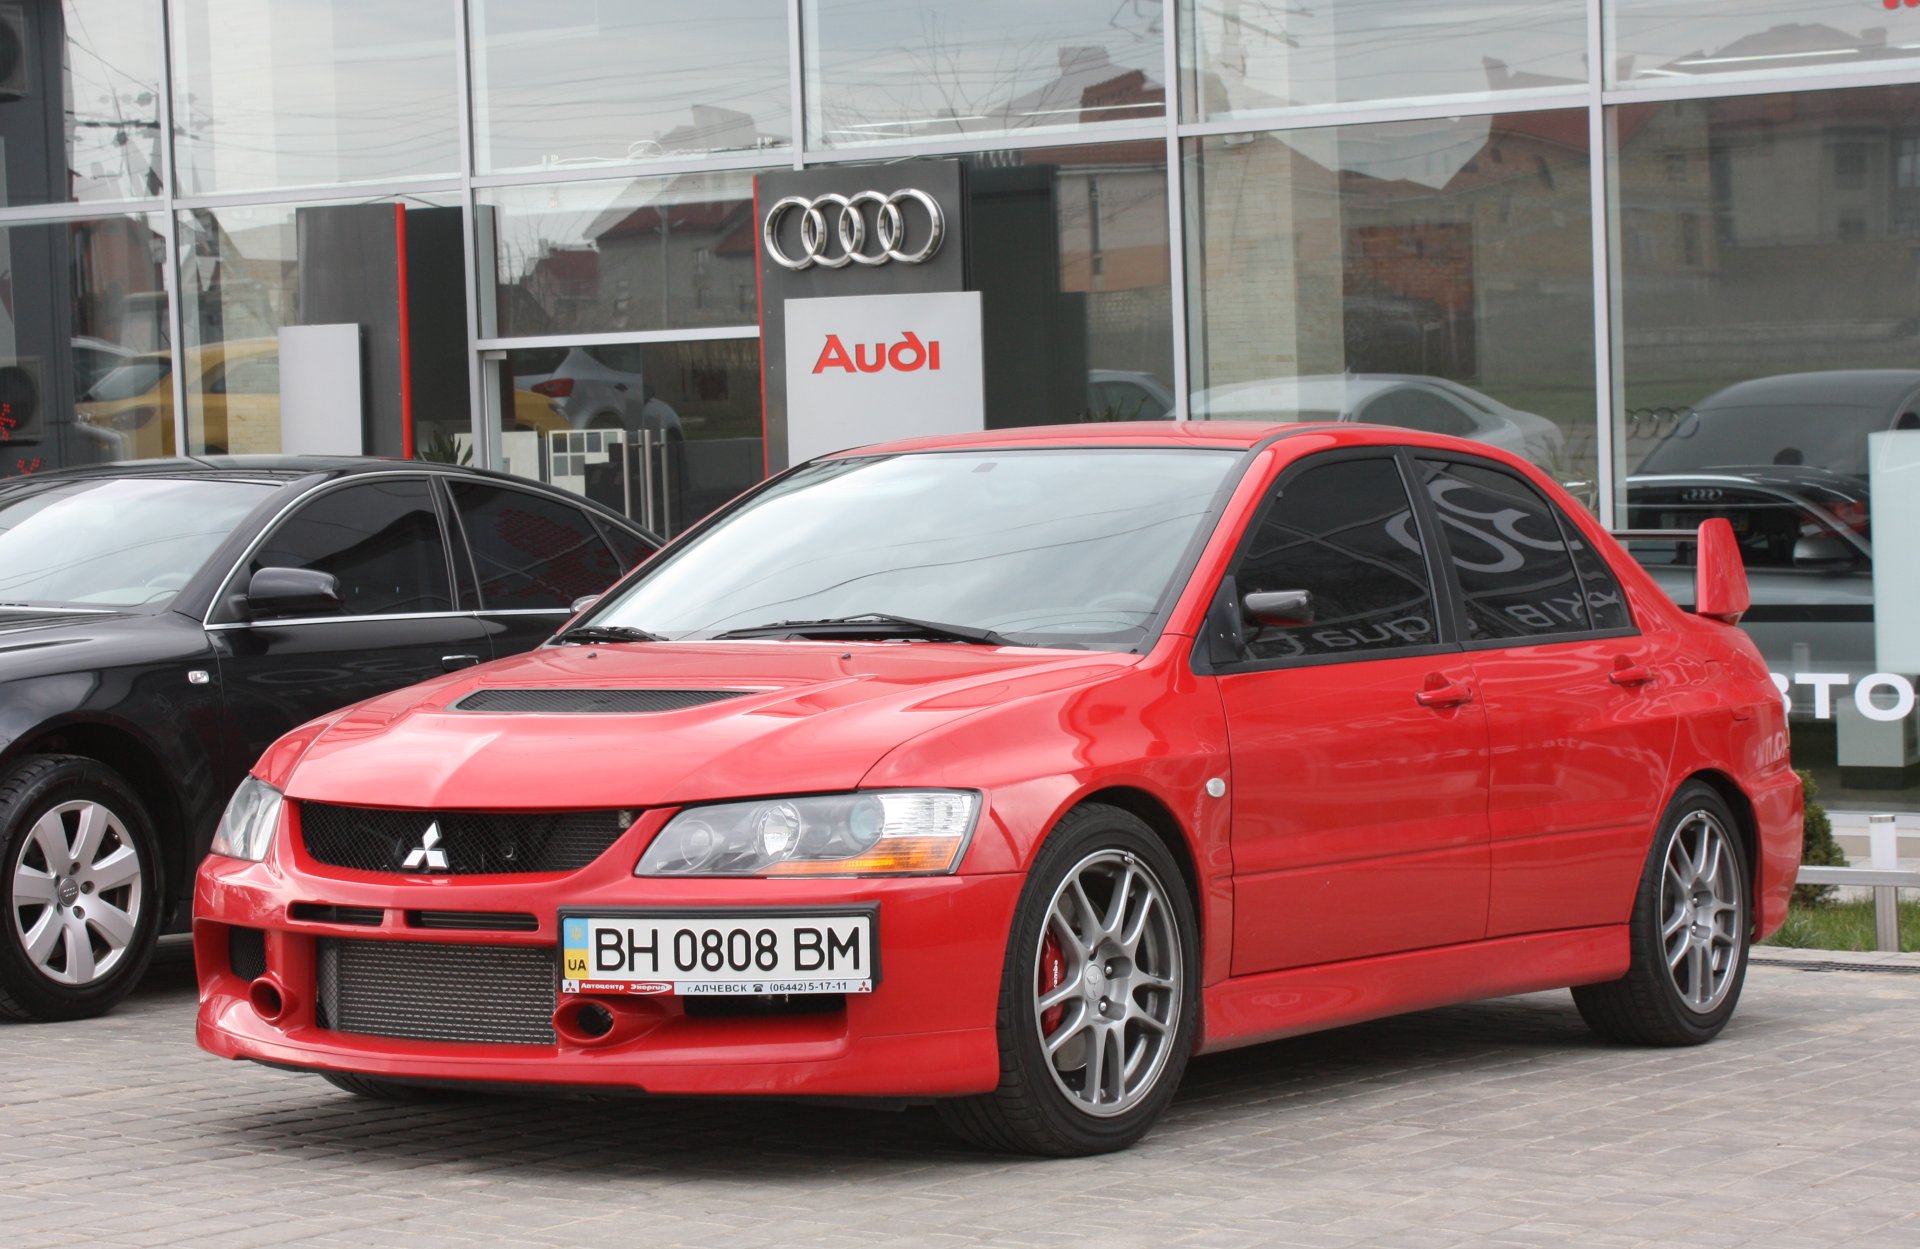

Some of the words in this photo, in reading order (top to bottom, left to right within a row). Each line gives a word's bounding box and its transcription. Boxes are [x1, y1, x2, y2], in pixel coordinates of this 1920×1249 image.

[812, 331, 940, 375] Audi
[595, 928, 659, 972] BH
[673, 928, 779, 972] 0808
[793, 926, 861, 971] BM
[568, 959, 587, 971] UA
[581, 983, 625, 992] Автоцентр
